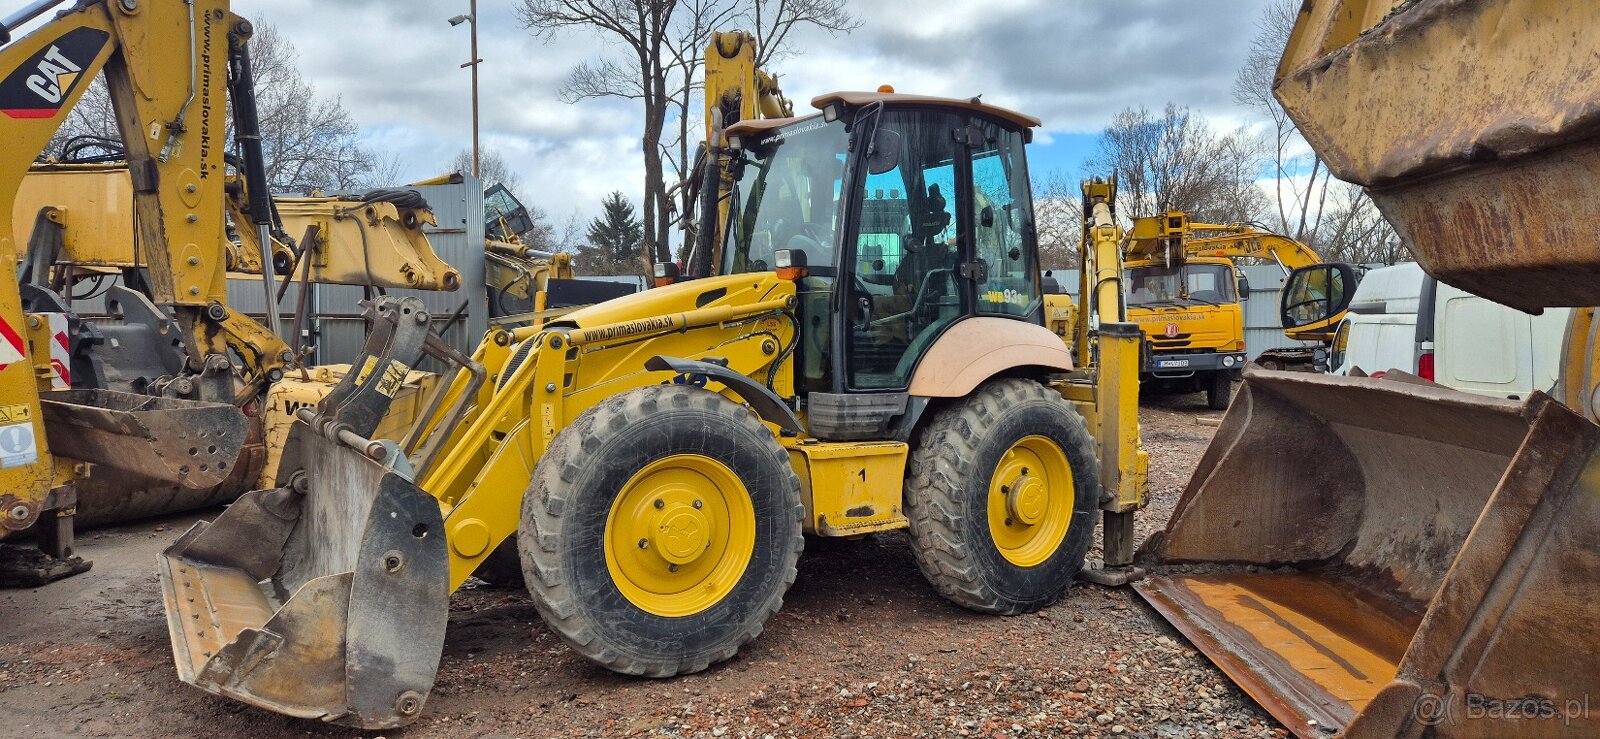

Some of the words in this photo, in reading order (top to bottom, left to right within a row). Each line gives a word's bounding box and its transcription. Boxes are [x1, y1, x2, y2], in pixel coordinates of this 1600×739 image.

[26, 45, 82, 103] CAT
[201, 9, 211, 180] www.primaslovakia.sk
[1244, 239, 1262, 254] JCB
[584, 316, 674, 342] www.primaslovakia.sk
[858, 467, 866, 482] 1
